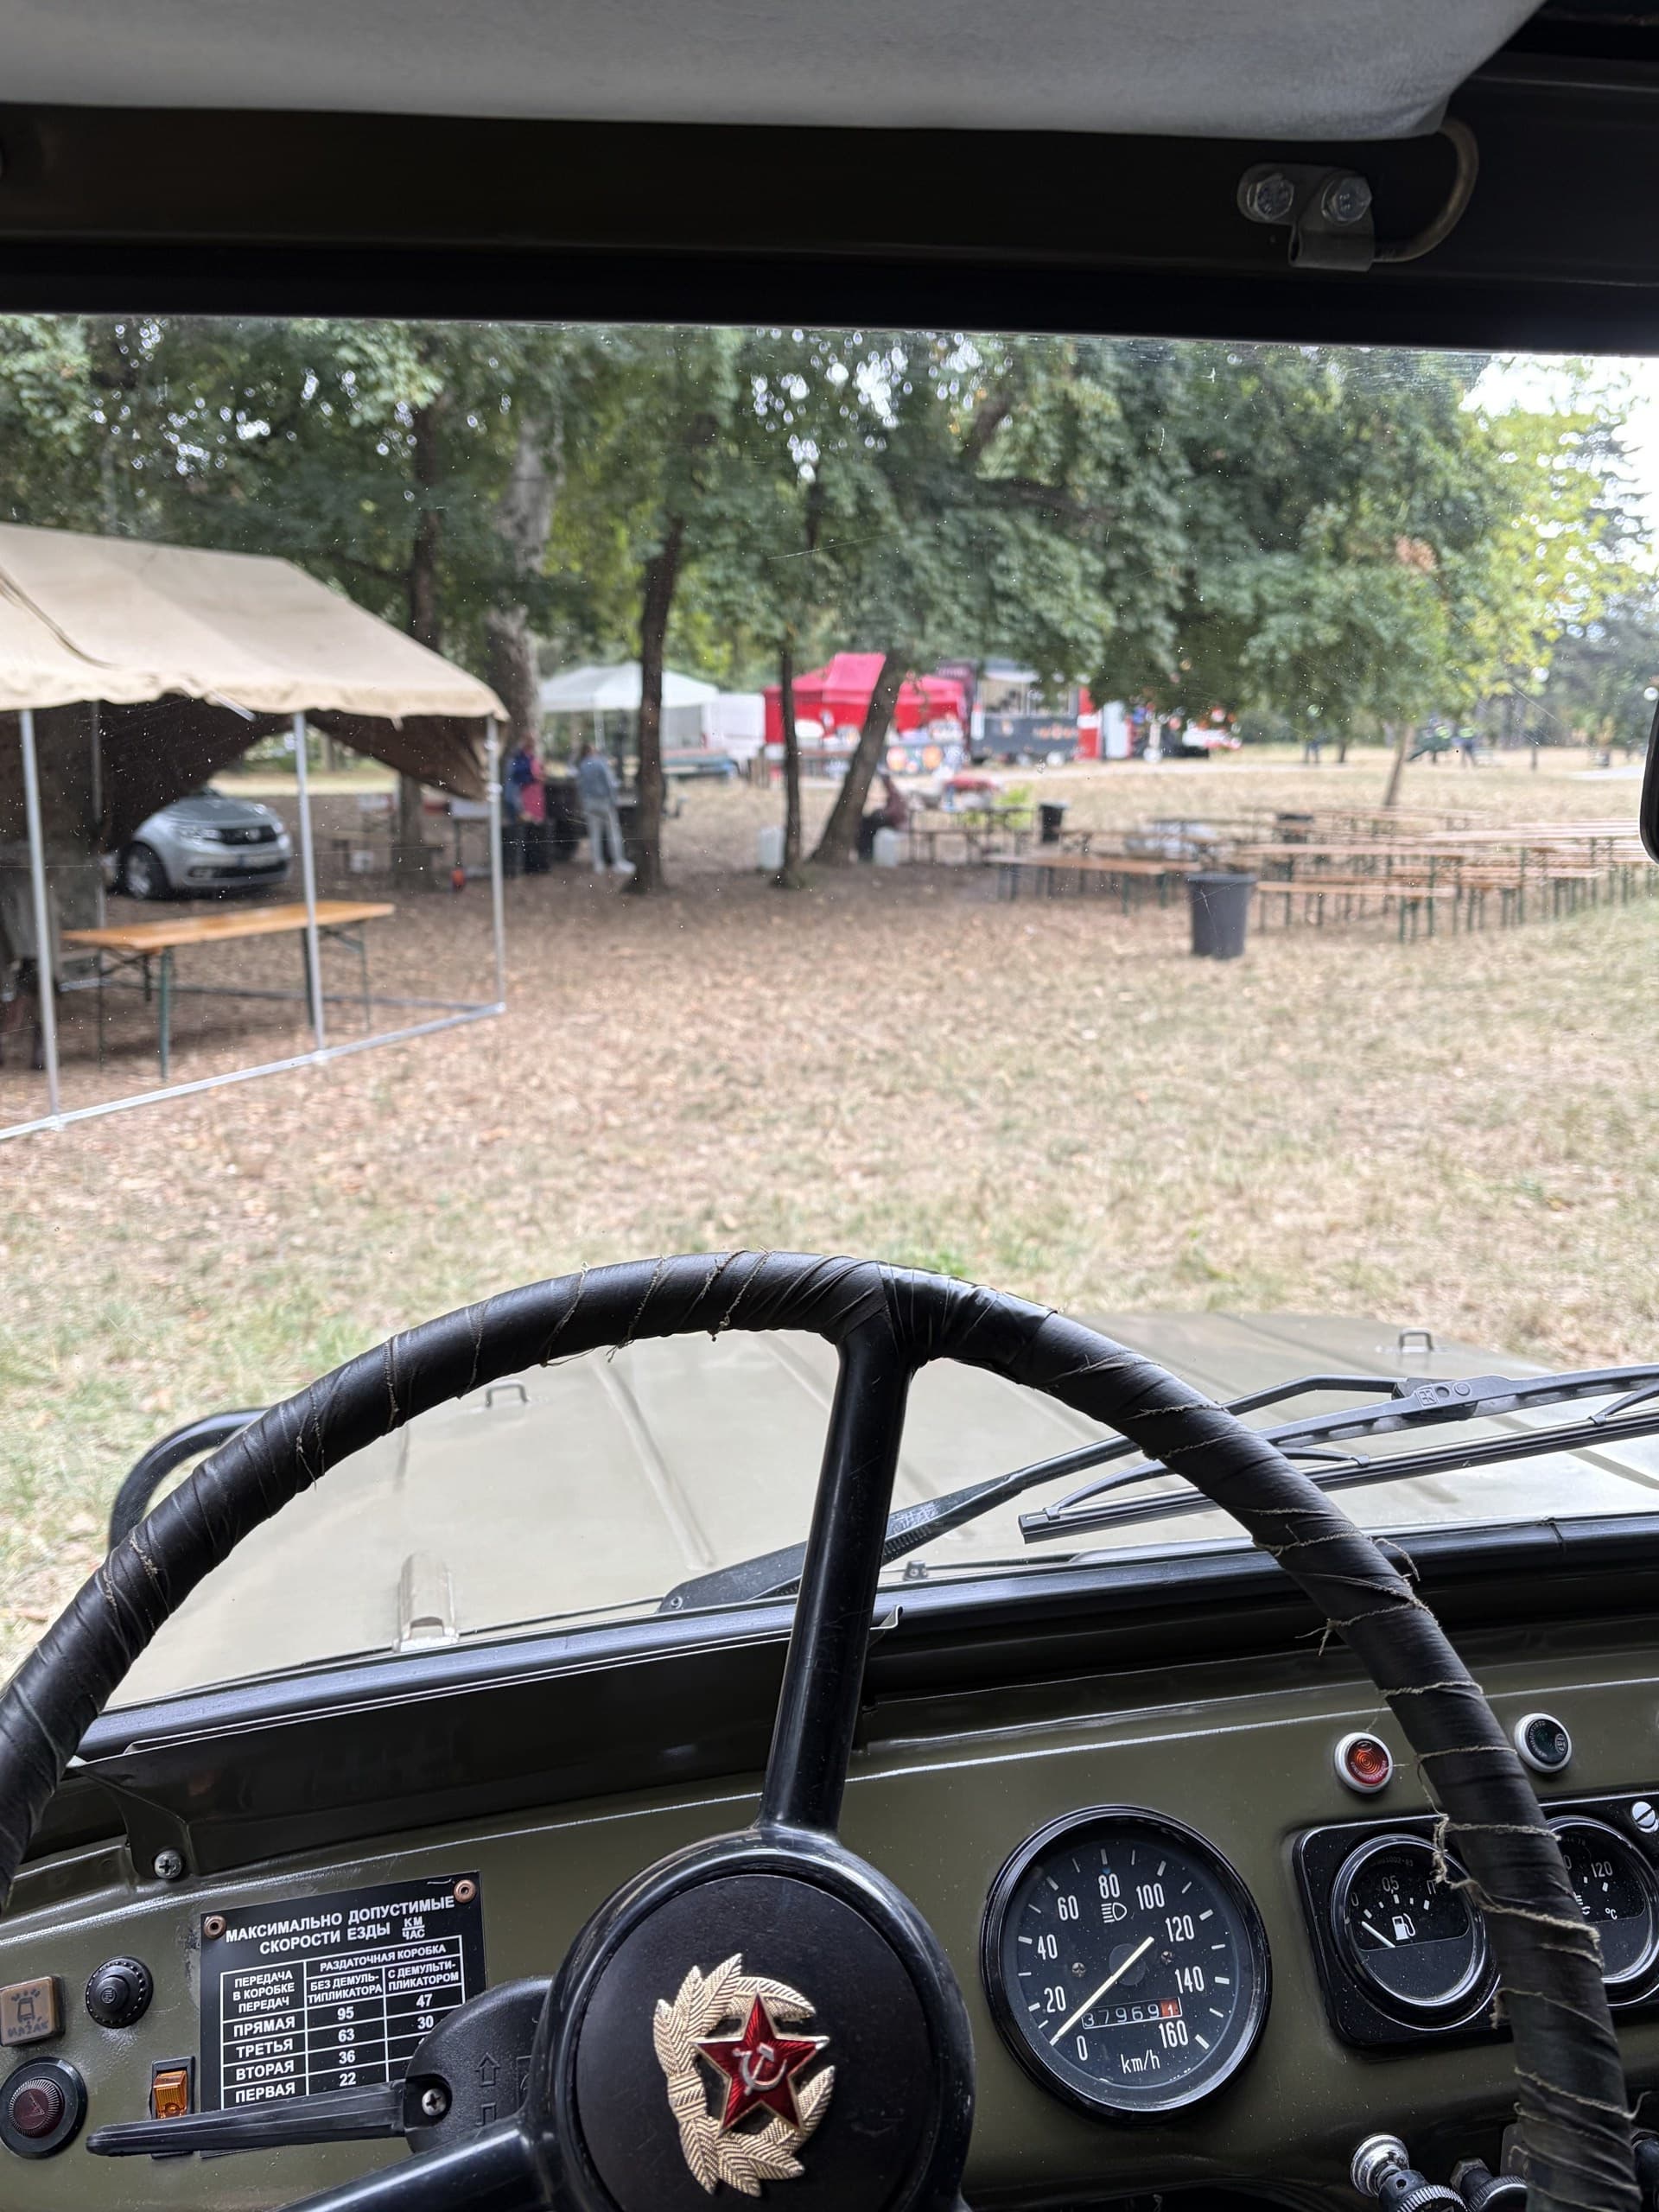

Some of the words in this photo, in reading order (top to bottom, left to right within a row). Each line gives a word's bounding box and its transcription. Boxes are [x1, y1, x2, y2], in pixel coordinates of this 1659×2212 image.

[1591, 1861, 1613, 1878] 120
[1098, 1873, 1120, 1898] 80
[1136, 1884, 1165, 1910] 100
[1351, 1892, 1359, 1906] 0
[226, 1912, 342, 1942] МАКСИМАЛЬНО
[348, 1896, 454, 1924] ДОПУСТИМЫЕ
[1058, 1896, 1078, 1921] 60
[404, 1916, 423, 1927] КМ
[1166, 1915, 1194, 1942] 120
[260, 1931, 340, 1955] СКОРОСТИ
[347, 1923, 391, 1944] ЕЗДЫ
[402, 1928, 425, 1940] ЧАС
[1037, 1935, 1058, 1960] 40
[320, 1952, 395, 1973] РАЗДАТОЧНАЯ
[397, 1945, 446, 1961] КОРОБКА
[235, 1970, 293, 1988] ПЕРЕДАЧА
[388, 1968, 395, 1979] С
[397, 1961, 456, 1979] ДЕМУЛЬТИ-
[1175, 1967, 1205, 1993] 140
[233, 1991, 241, 2001] В
[244, 1983, 295, 1999] КОРОБКЕ
[311, 1980, 331, 1992] БЕЗ
[333, 1974, 379, 1989] ДЕМУЛЬ-
[389, 1972, 459, 1991] ПЛИКАТОРОМ
[308, 1983, 382, 2004] ТИПЛИКАТОРА
[416, 1993, 433, 2008] 47
[1044, 1986, 1065, 2012] 20
[238, 1997, 289, 2013] ПЕРЕДАЧ
[337, 2006, 354, 2020] 95
[233, 2016, 295, 2037] ПРЯМАЯ
[417, 2015, 434, 2030] 30
[338, 2028, 355, 2043] 63
[1159, 2021, 1188, 2048] 160
[236, 2038, 293, 2059] ТРЕТЬЯ
[339, 2050, 355, 2065] 36
[1077, 2036, 1088, 2061] 0
[236, 2060, 295, 2081] ВТОРАЯ
[1121, 2050, 1160, 2074] km/h
[340, 2072, 356, 2088] 22
[235, 2082, 296, 2103] ПЕРВАЯ
